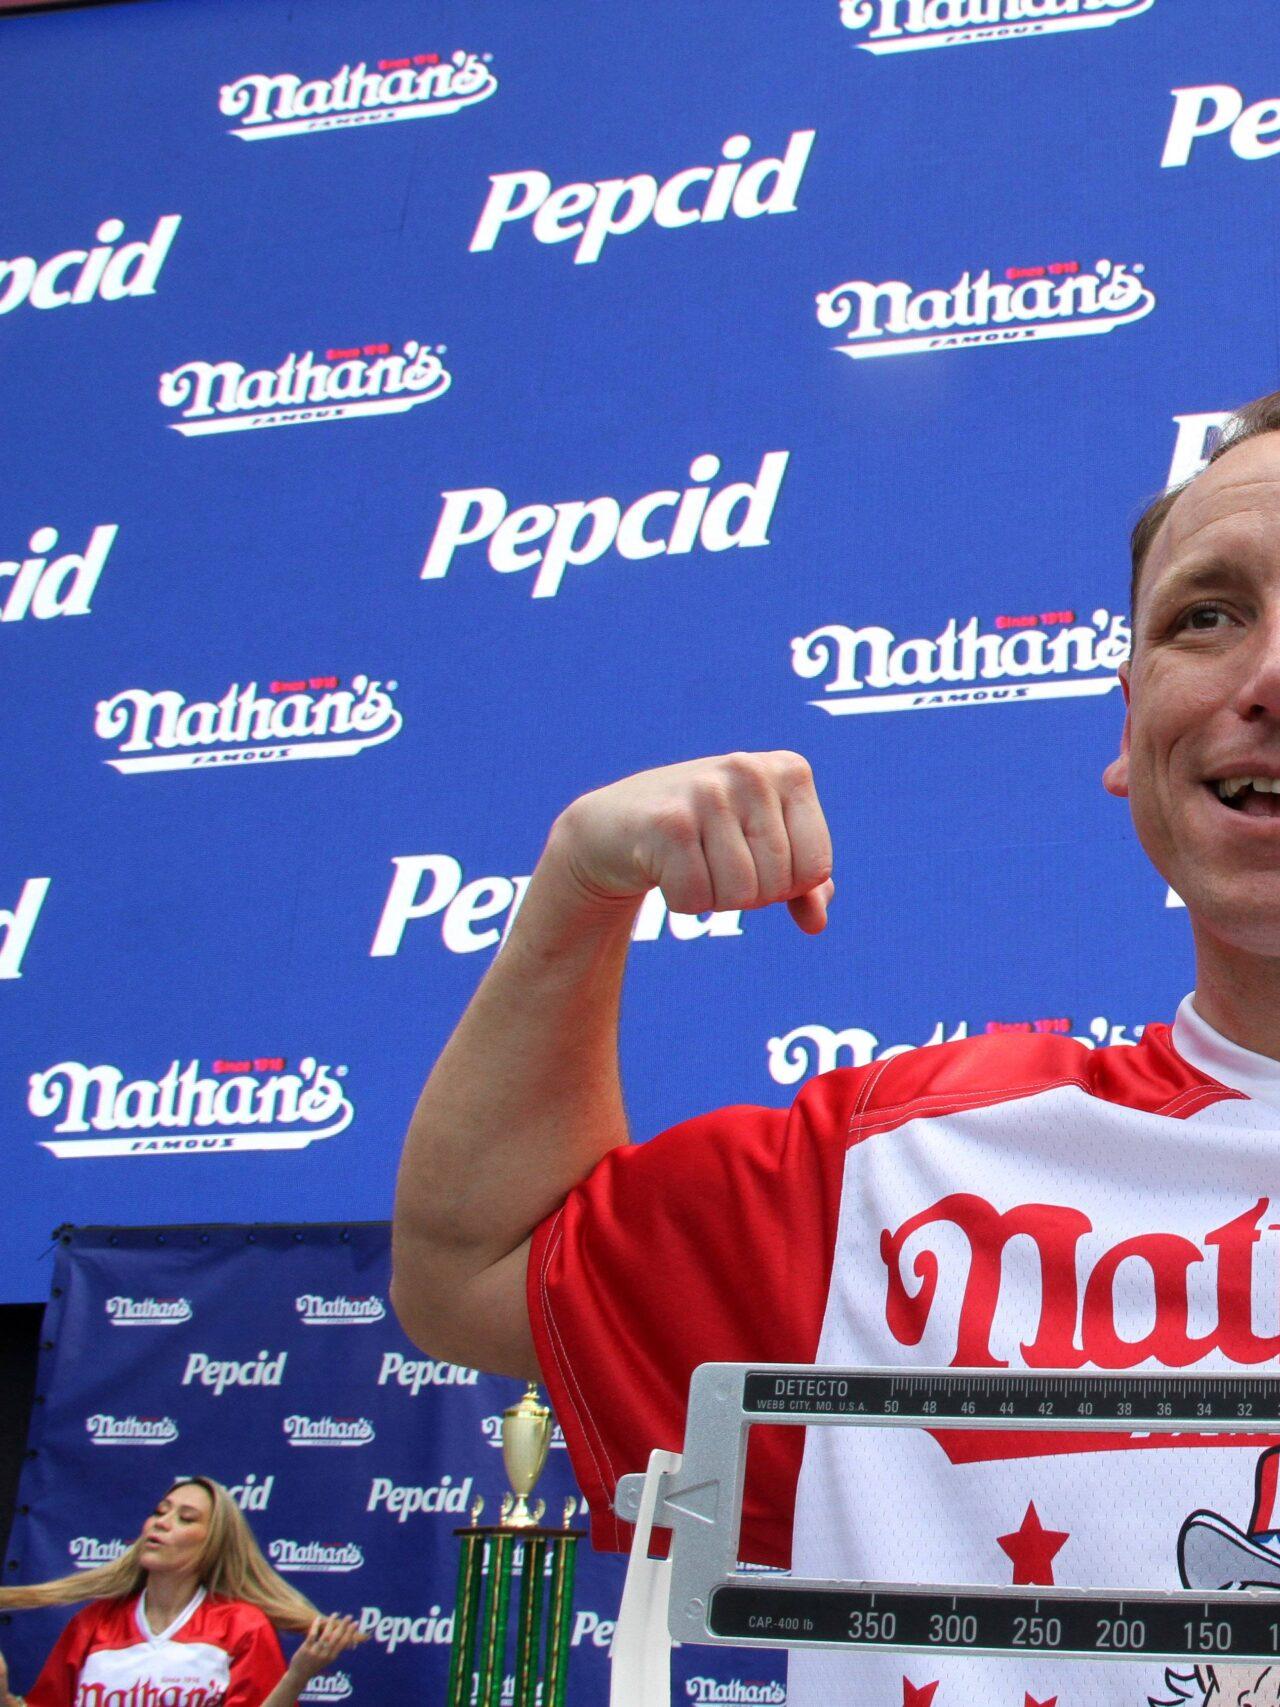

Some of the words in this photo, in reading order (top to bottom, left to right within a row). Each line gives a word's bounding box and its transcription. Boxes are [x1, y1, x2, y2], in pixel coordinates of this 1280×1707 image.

[219, 50, 489, 125] Nathan's
[469, 130, 816, 263] Pepcid
[815, 259, 1143, 339] Nathan's
[158, 340, 442, 417] Nathan's
[421, 452, 790, 599] Pepcid
[94, 674, 393, 752] Nathan's
[27, 1057, 343, 1132] Nathan's
[106, 1296, 191, 1318] Nathan's
[296, 1294, 384, 1318] Nathan's
[181, 1350, 288, 1396] Pepcid
[775, 1379, 848, 1397] DETECTO
[757, 1400, 785, 1409] WEBB
[884, 1401, 899, 1413] 50
[922, 1401, 937, 1414] 48
[961, 1402, 976, 1414] 46
[1000, 1402, 1014, 1415] 44
[1038, 1402, 1053, 1415] 42
[1078, 1403, 1093, 1416] 40
[1117, 1403, 1132, 1416] 38
[1157, 1403, 1172, 1416] 36
[1197, 1403, 1212, 1417] 34
[1238, 1403, 1252, 1417] 32
[86, 1414, 176, 1438] Nathan's
[284, 1415, 373, 1439] Nathan's
[367, 1475, 473, 1523] Pepcid
[269, 1538, 361, 1563] Nathan's
[803, 1619, 814, 1631] lb
[848, 1612, 896, 1640] 350
[929, 1614, 977, 1643] 300
[1012, 1617, 1061, 1646] 250
[1096, 1620, 1146, 1649] 200
[1184, 1622, 1232, 1651] 150
[686, 1676, 786, 1703] Nathan's
